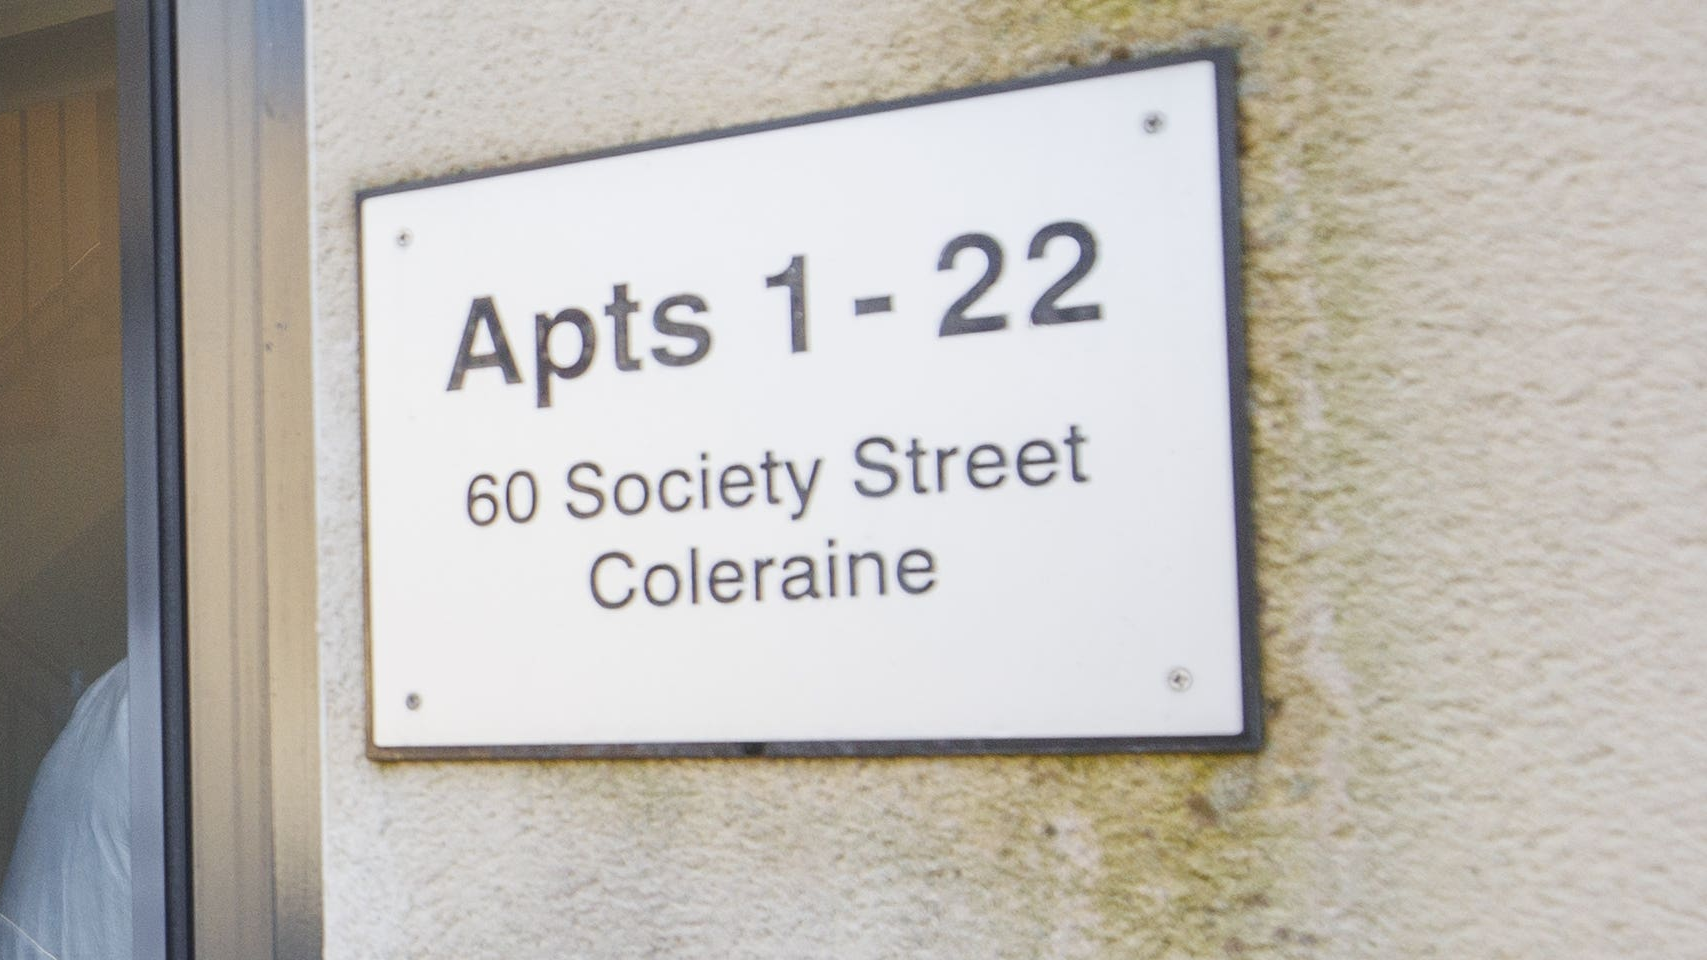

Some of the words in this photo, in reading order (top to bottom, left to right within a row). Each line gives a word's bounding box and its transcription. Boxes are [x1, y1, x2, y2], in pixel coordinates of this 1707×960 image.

[445, 282, 712, 409] Apts
[764, 254, 808, 354] 1
[852, 294, 894, 316] -
[935, 219, 1103, 338] 22
[465, 469, 539, 528] 60
[564, 450, 824, 523] Society
[853, 424, 1092, 499] Street
[589, 539, 939, 611] Coleraine
